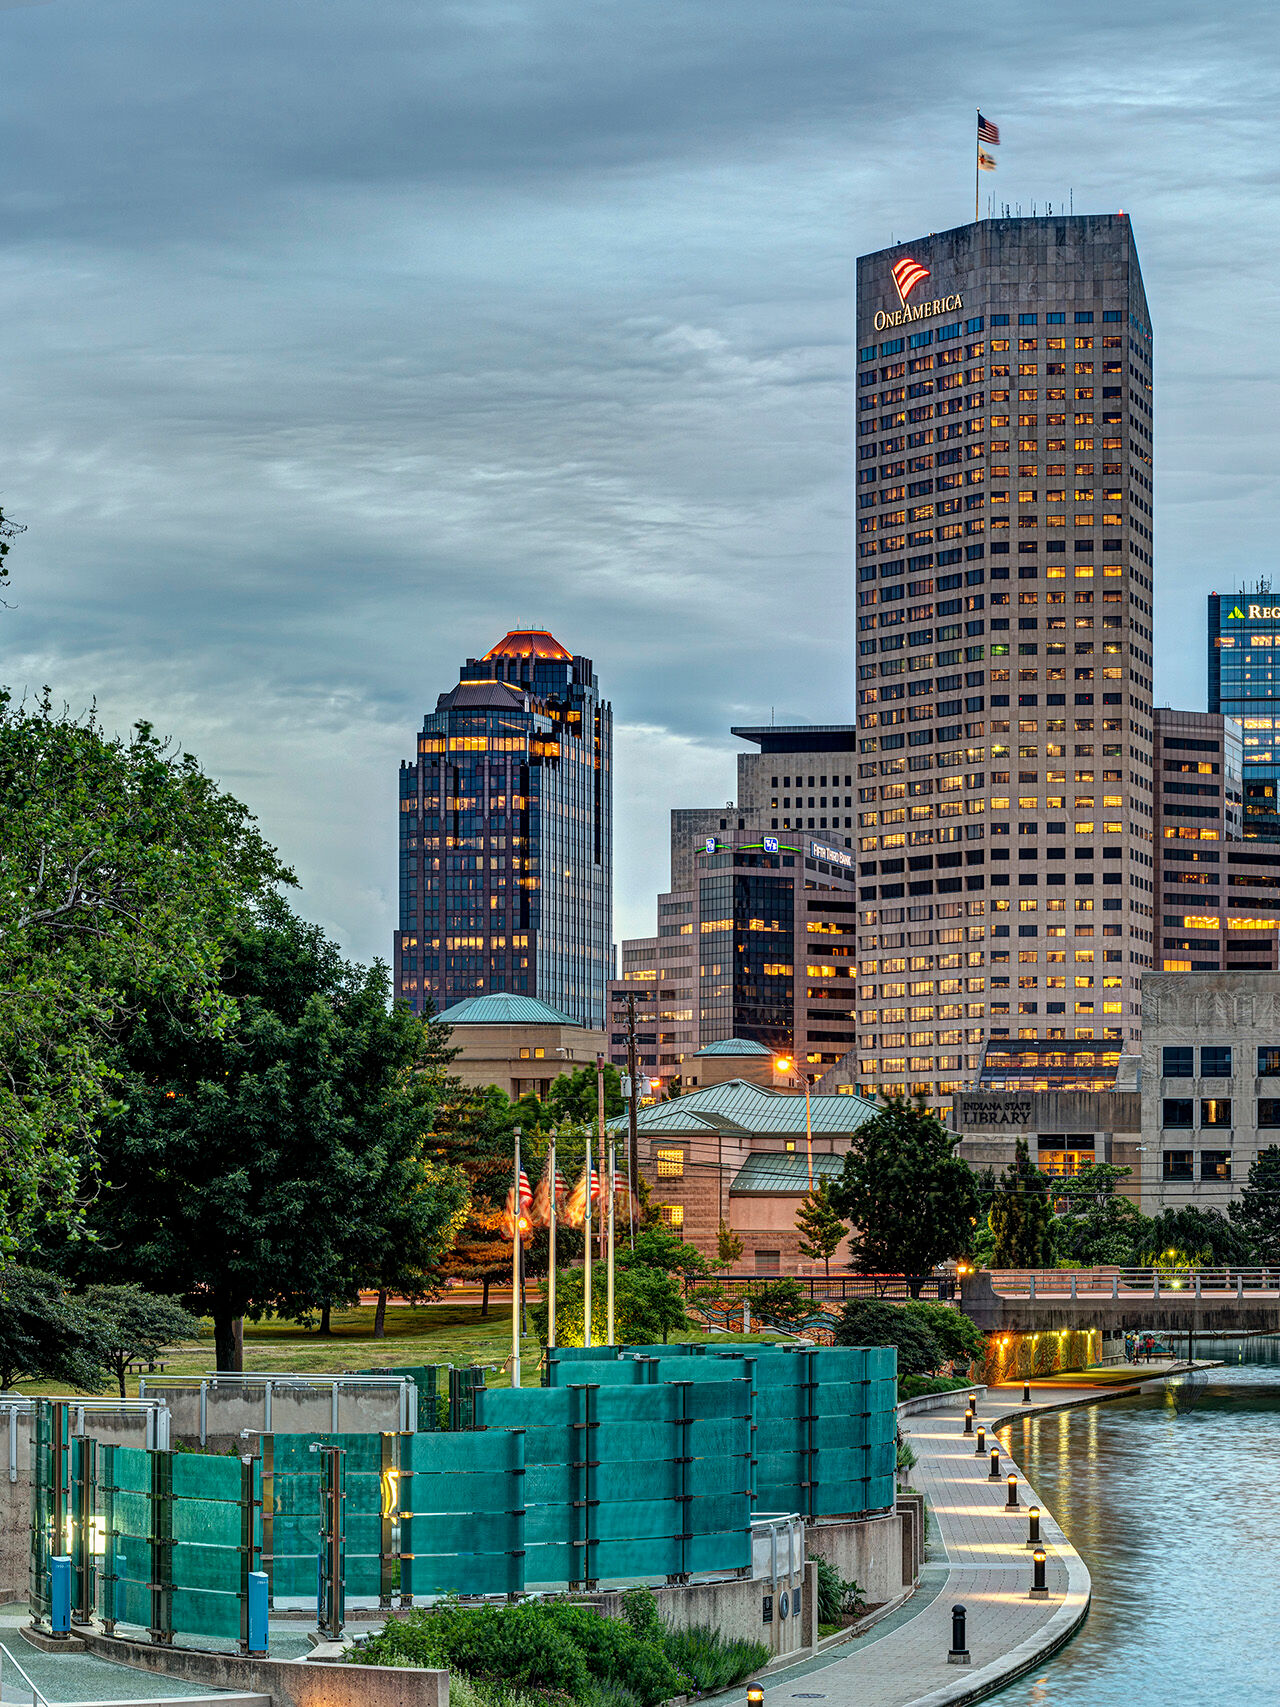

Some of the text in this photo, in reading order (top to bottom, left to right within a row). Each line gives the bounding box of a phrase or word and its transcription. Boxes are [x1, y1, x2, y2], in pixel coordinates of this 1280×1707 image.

[963, 1102, 1031, 1111] INDIANA STATE
[963, 1111, 1031, 1124] LIBRARY
